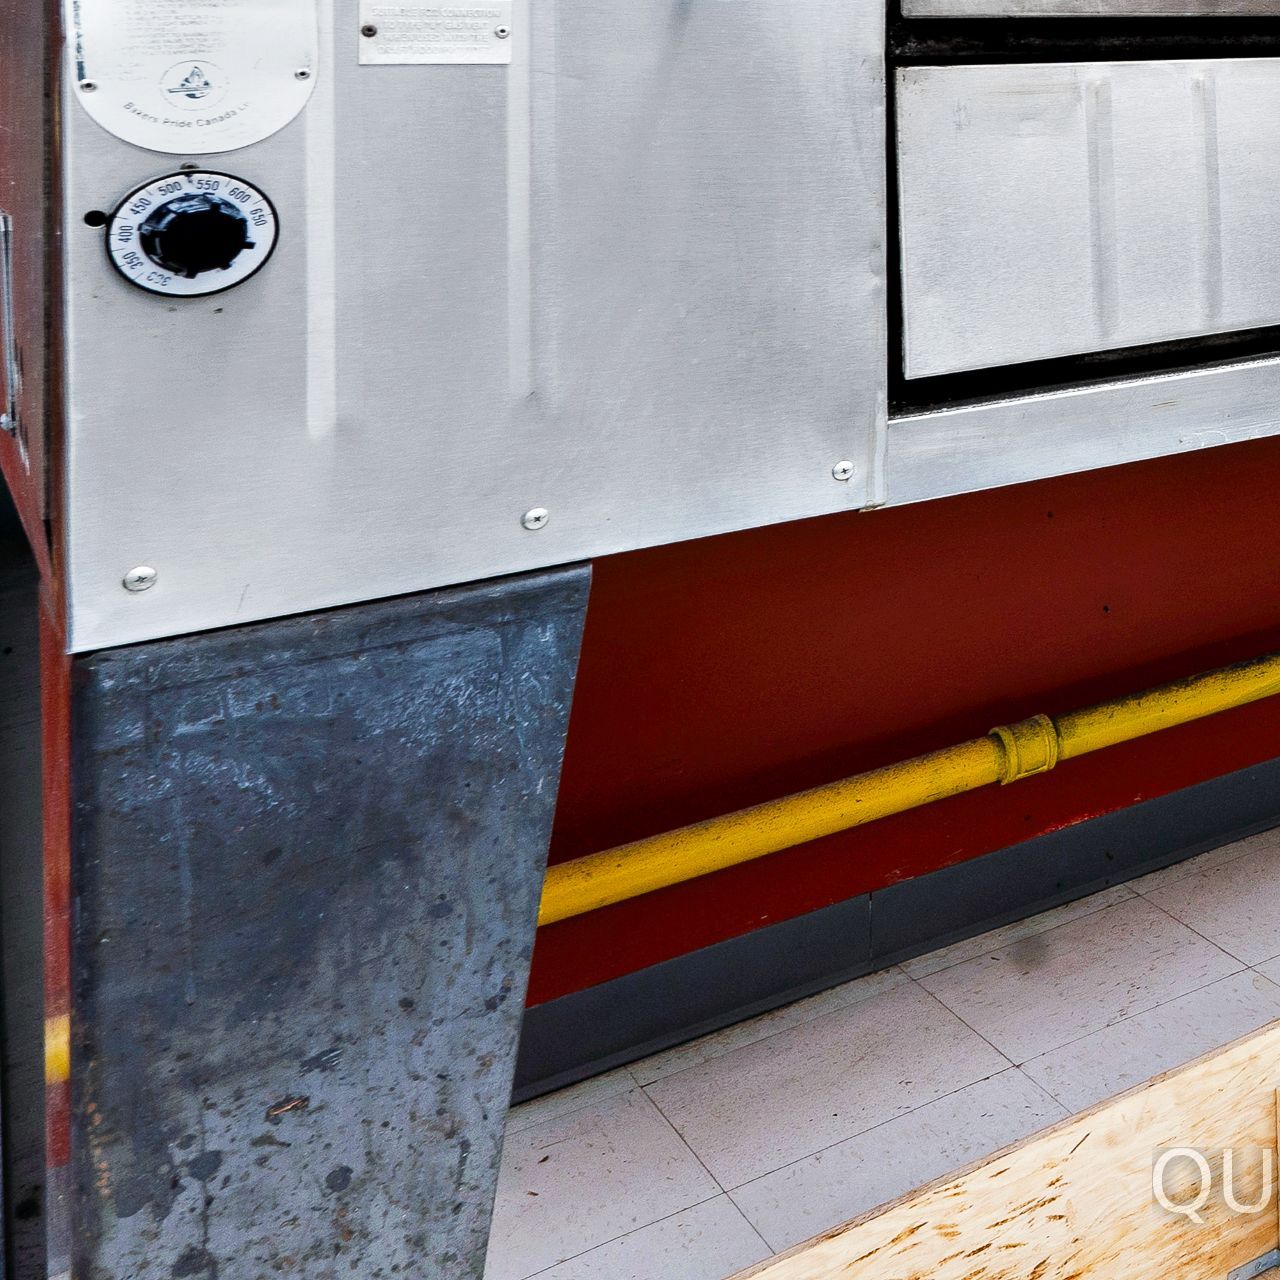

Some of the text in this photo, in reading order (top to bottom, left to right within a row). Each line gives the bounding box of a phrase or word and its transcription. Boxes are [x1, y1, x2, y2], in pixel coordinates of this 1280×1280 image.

[162, 118, 192, 128] Pride
[196, 109, 238, 127] Canada
[158, 181, 182, 197] 500
[196, 179, 220, 191] 550
[228, 187, 251, 204] 600
[129, 197, 152, 216] 450
[250, 207, 268, 227] 650
[118, 225, 134, 243] 400
[122, 251, 145, 270] 350
